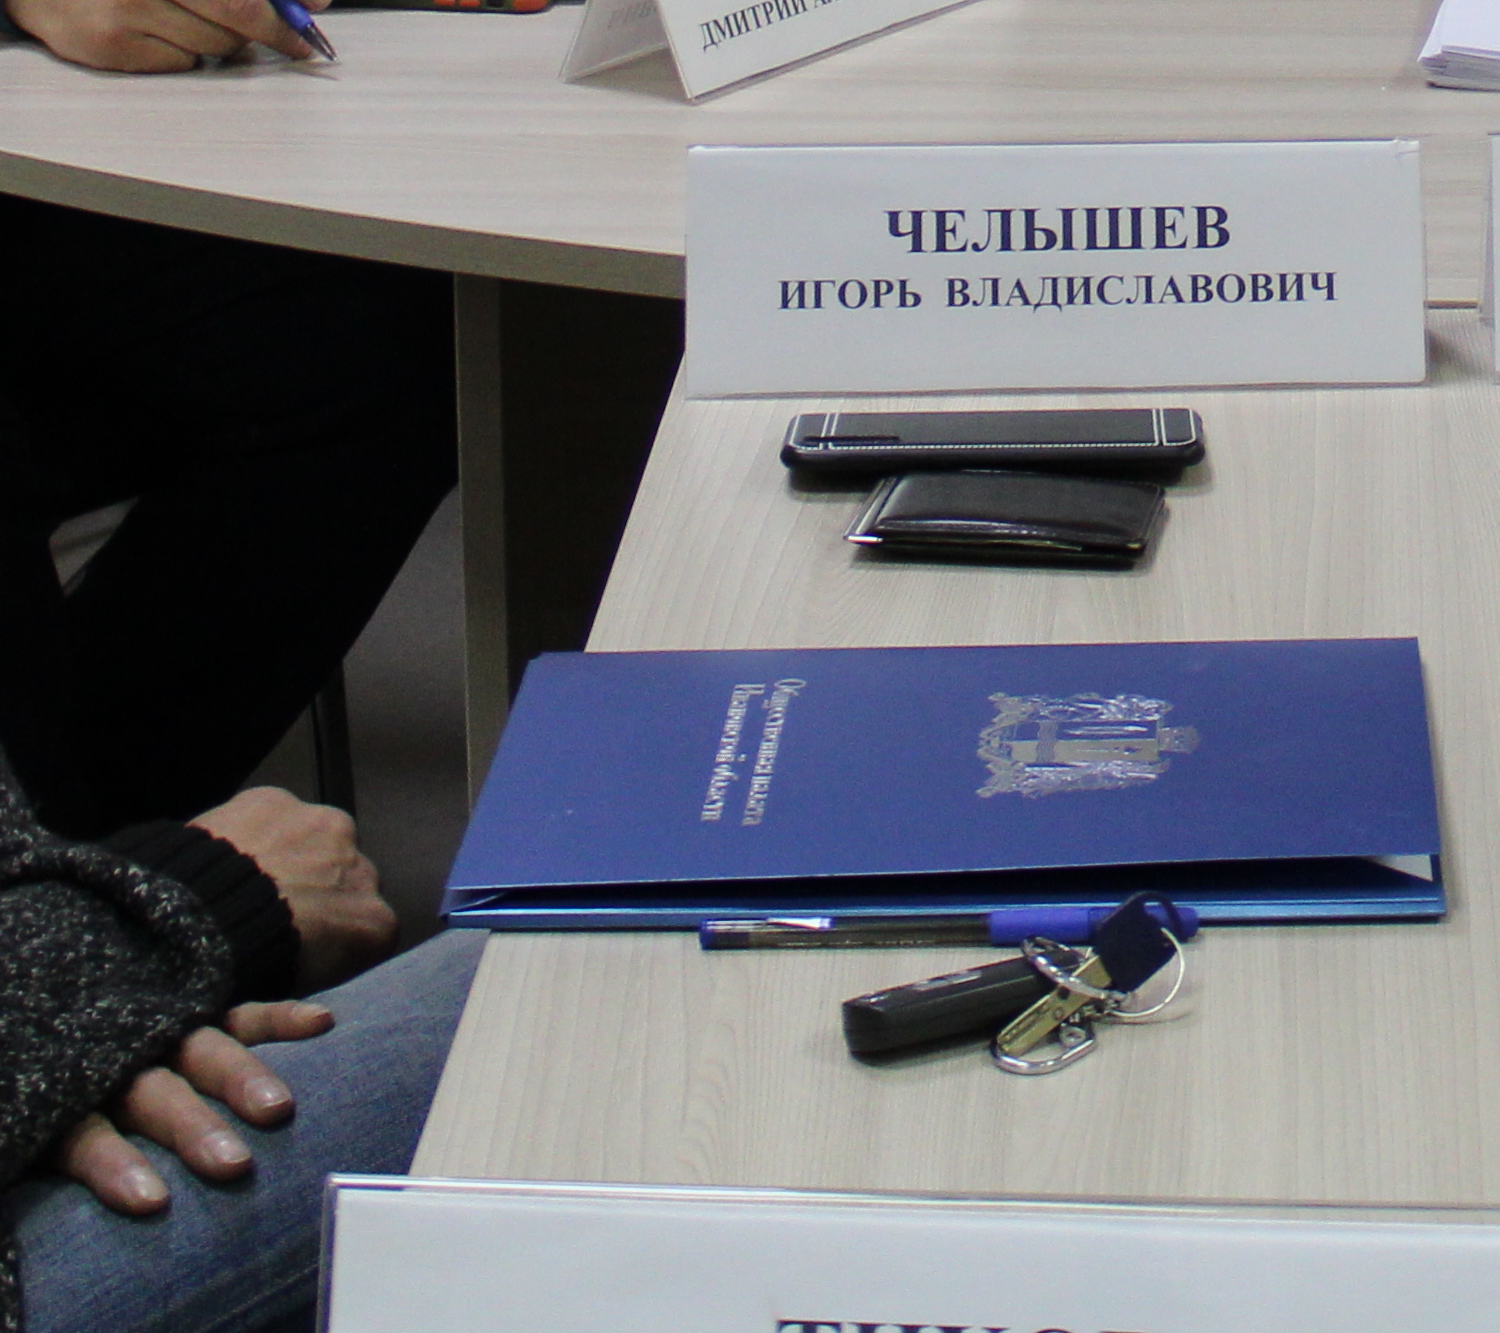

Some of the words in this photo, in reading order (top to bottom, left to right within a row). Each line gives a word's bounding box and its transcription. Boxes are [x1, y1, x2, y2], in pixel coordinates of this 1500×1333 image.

[884, 205, 1232, 252] ЧЕЛЫШЕВ
[778, 279, 922, 310] ИГОРЬ
[946, 271, 1338, 313] ВЛАДИСЛАВОВИЧ
